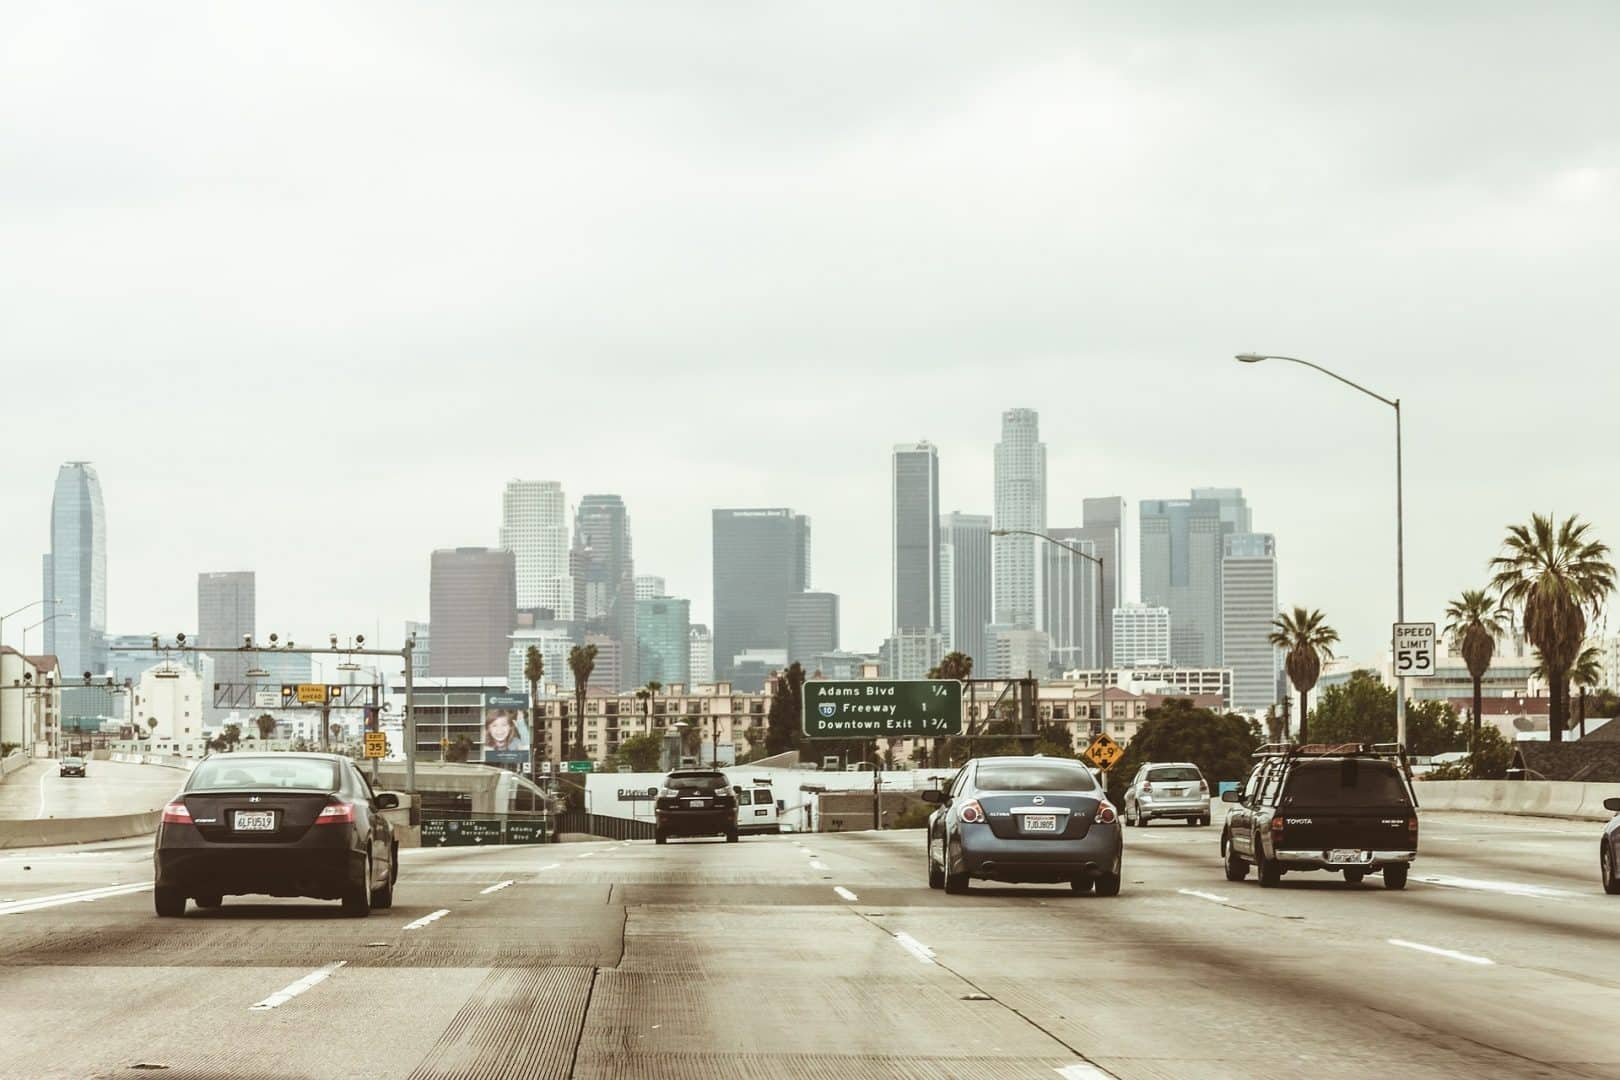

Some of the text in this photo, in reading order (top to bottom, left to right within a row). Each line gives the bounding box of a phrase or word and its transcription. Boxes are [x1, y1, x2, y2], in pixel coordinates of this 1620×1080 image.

[1397, 627, 1432, 637] SPEED
[1400, 640, 1428, 649] LIMIT
[1398, 650, 1430, 670] 55
[818, 685, 947, 697] Adams Blvd 1/4
[843, 703, 896, 715] Freeway
[922, 703, 927, 711] 1
[818, 719, 880, 729] Downtown
[887, 719, 912, 729] Exit
[922, 720, 927, 728] 1
[369, 743, 382, 751] 35
